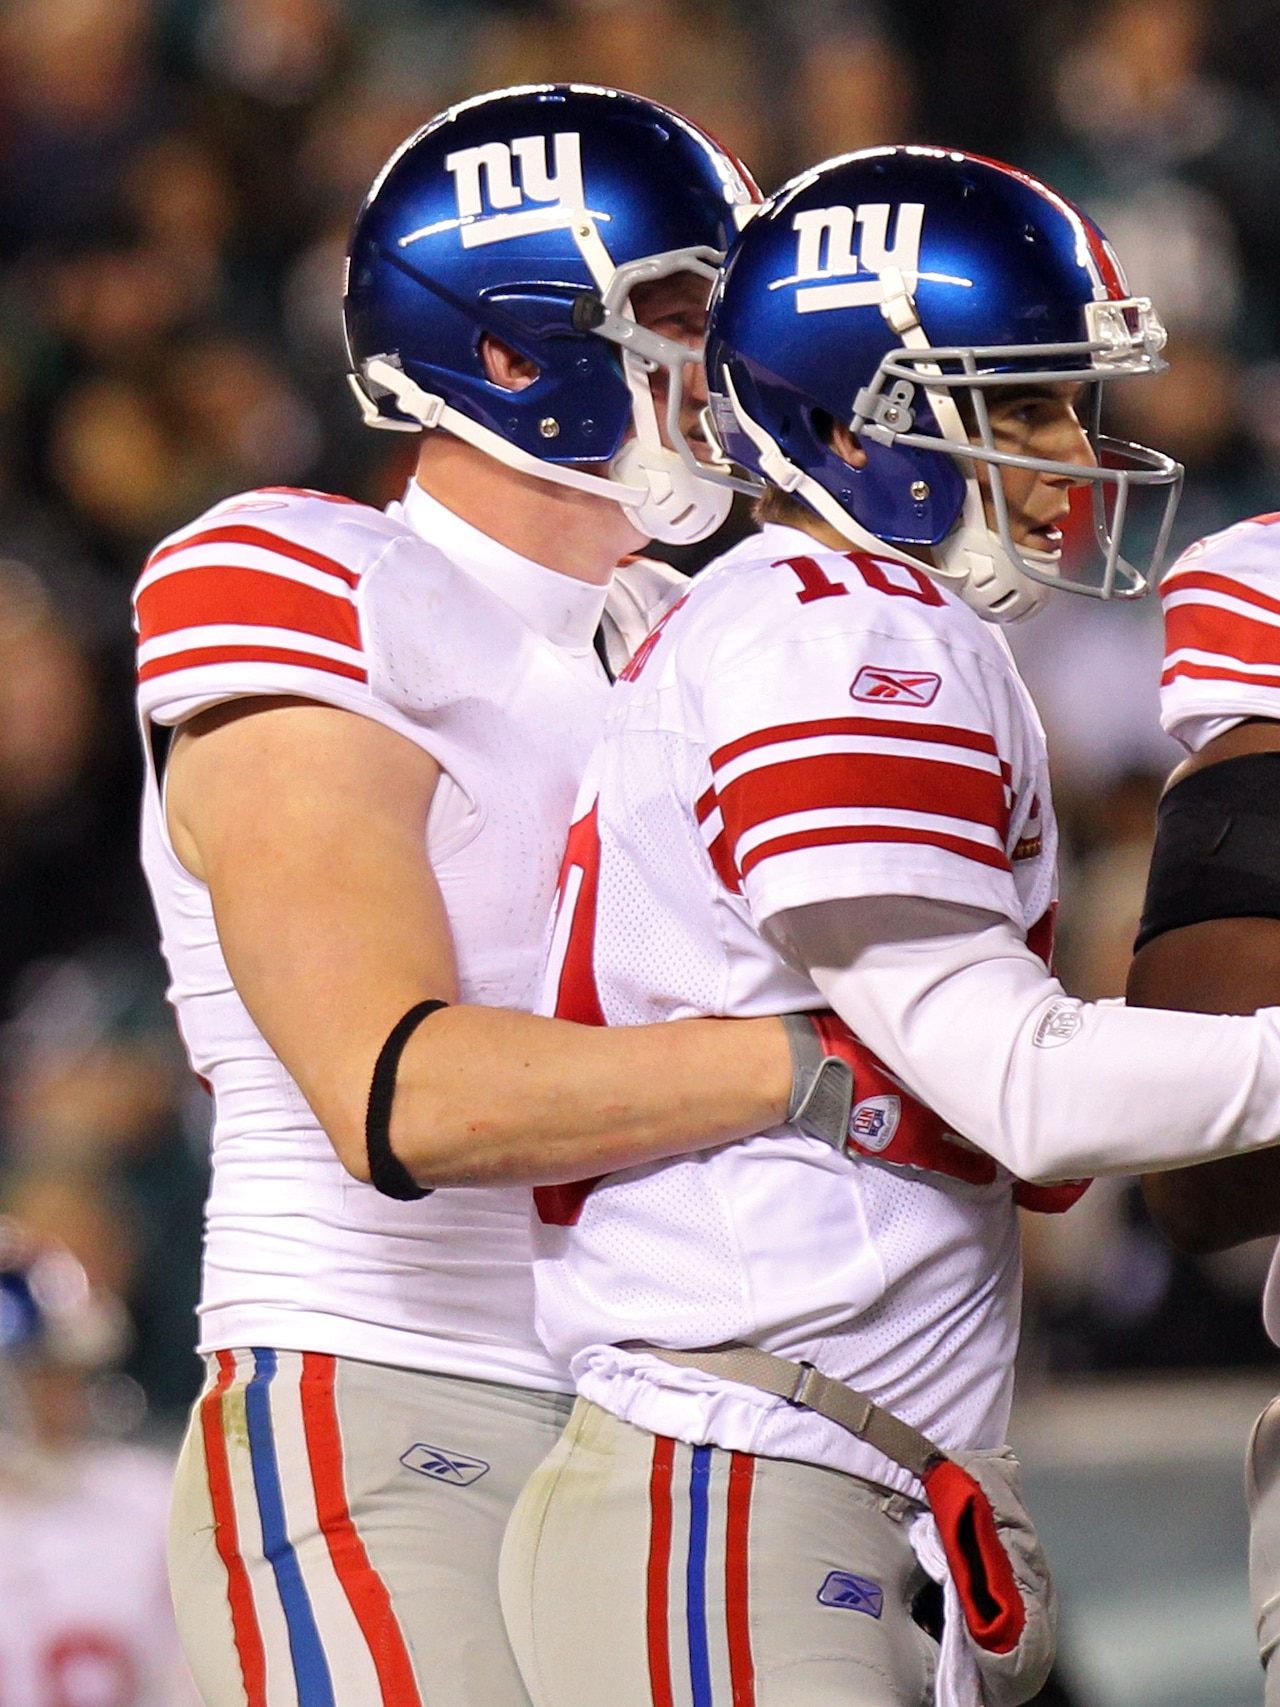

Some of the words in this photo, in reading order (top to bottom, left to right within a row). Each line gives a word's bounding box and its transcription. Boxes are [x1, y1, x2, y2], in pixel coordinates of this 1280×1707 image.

[446, 132, 585, 249] ny
[794, 203, 925, 312] ny
[770, 551, 949, 607] 10
